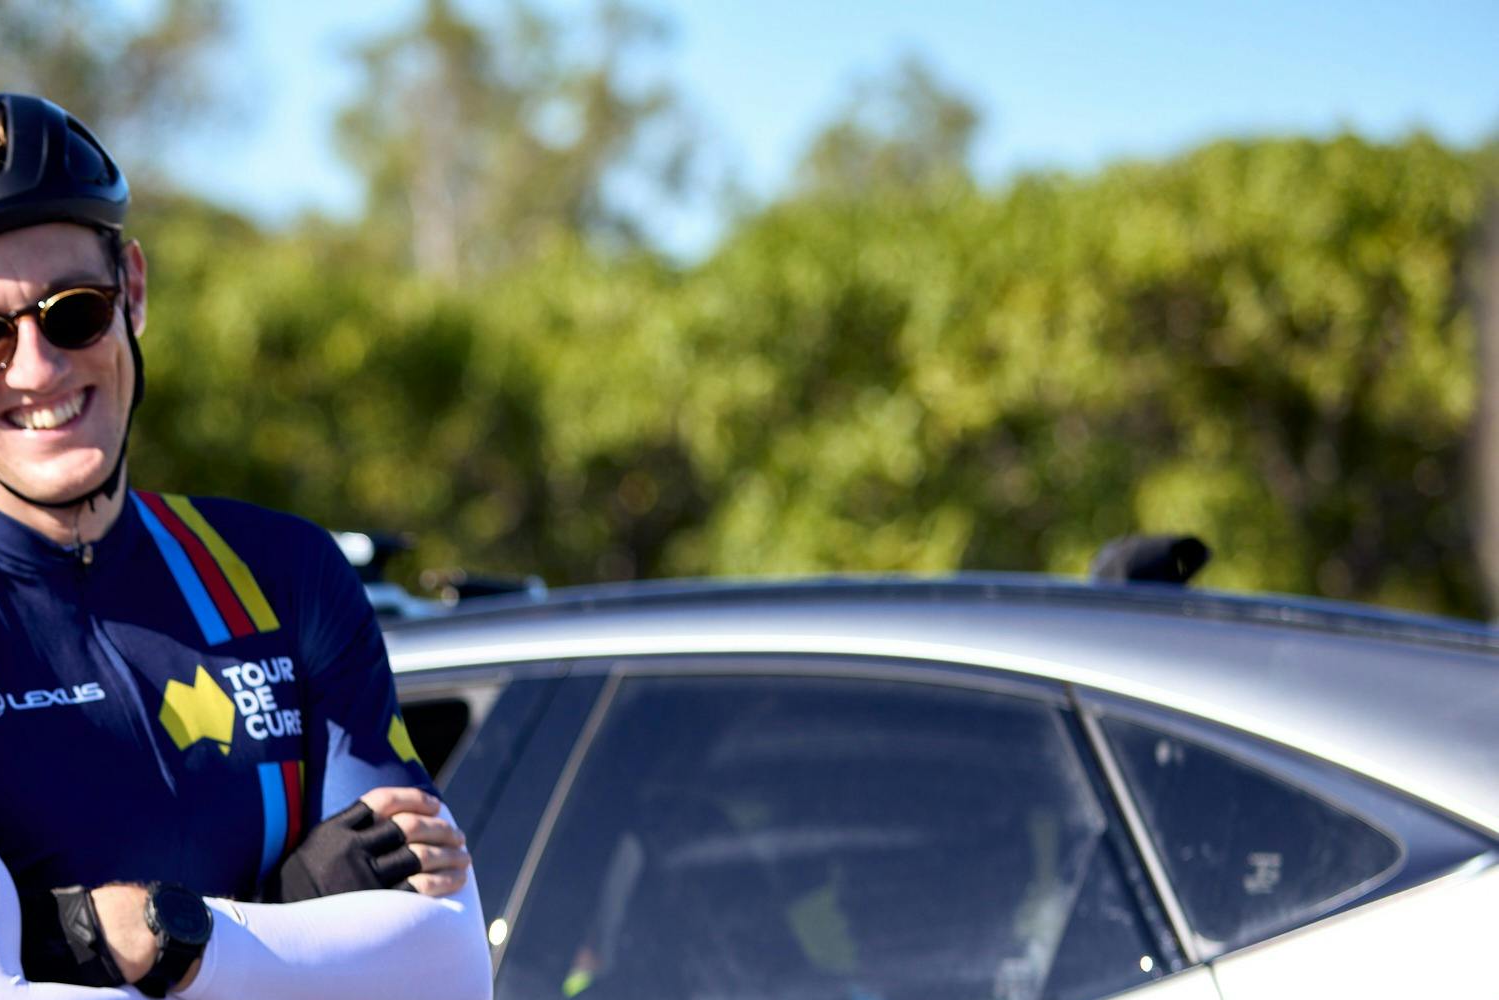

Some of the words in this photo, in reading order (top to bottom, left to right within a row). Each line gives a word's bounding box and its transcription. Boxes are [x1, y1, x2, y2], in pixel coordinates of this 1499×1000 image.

[221, 656, 296, 691] TOUR
[6, 682, 106, 710] LEXUS
[233, 685, 277, 717] DE
[245, 709, 303, 741] CURE
